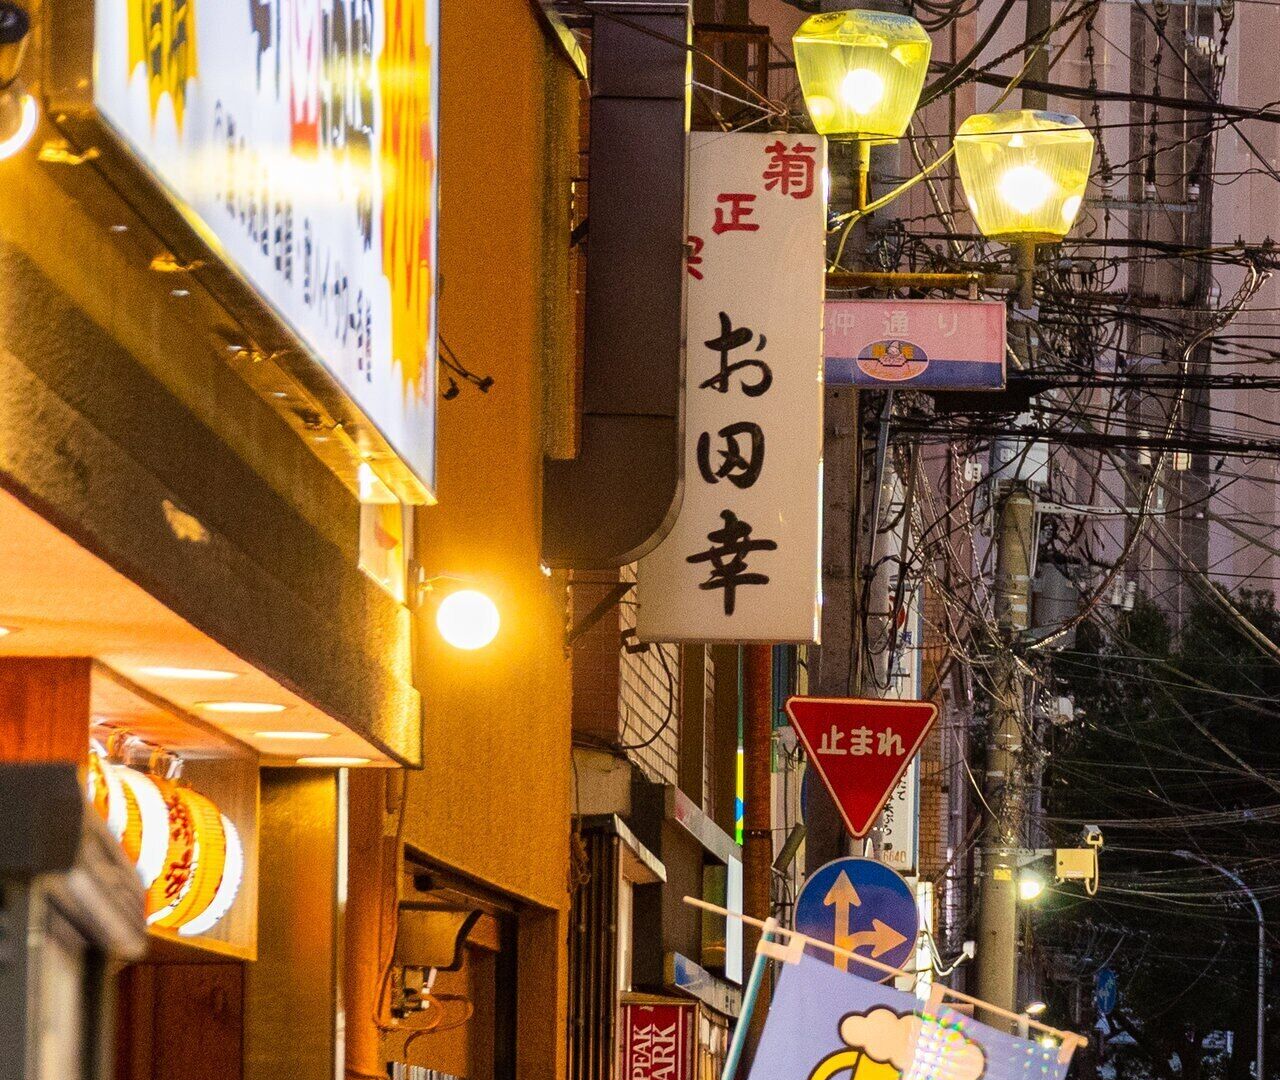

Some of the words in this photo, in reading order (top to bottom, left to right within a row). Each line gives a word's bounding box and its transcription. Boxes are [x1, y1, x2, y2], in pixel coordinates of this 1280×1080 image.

[830, 309, 959, 338] 仲通り
[815, 723, 906, 758] 止まれ
